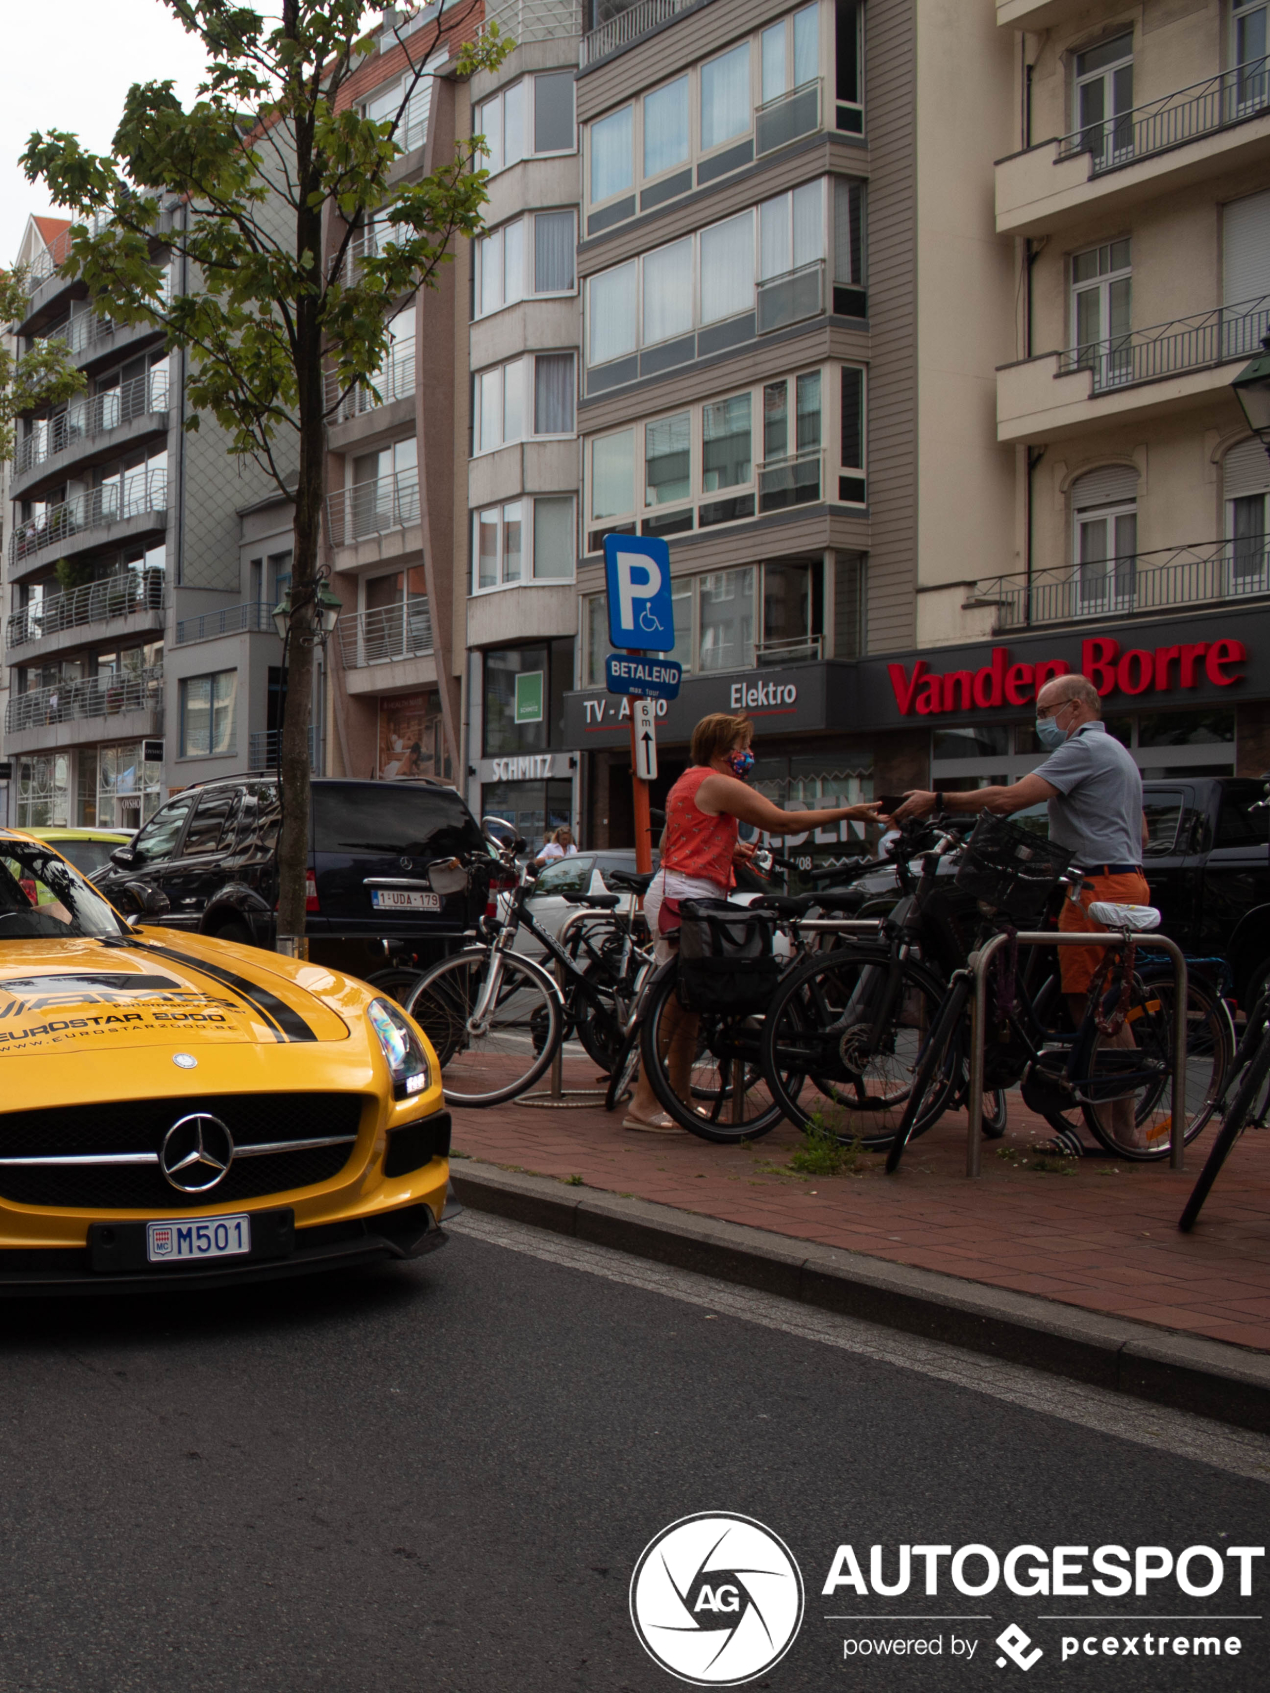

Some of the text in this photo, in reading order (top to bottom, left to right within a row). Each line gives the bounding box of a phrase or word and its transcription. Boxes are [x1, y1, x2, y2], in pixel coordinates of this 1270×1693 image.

[616, 551, 662, 630] P
[611, 660, 680, 685] BETALEND
[887, 636, 1247, 715] Vanden Borre
[730, 681, 798, 708] Elektro
[583, 700, 606, 723] TV
[618, 697, 668, 721] Aio
[641, 705, 650, 716] 6
[492, 755, 552, 781] SCHMITZ
[152, 1012, 227, 1023] 2000
[156, 1242, 169, 1251] MC
[176, 1221, 243, 1255] M501
